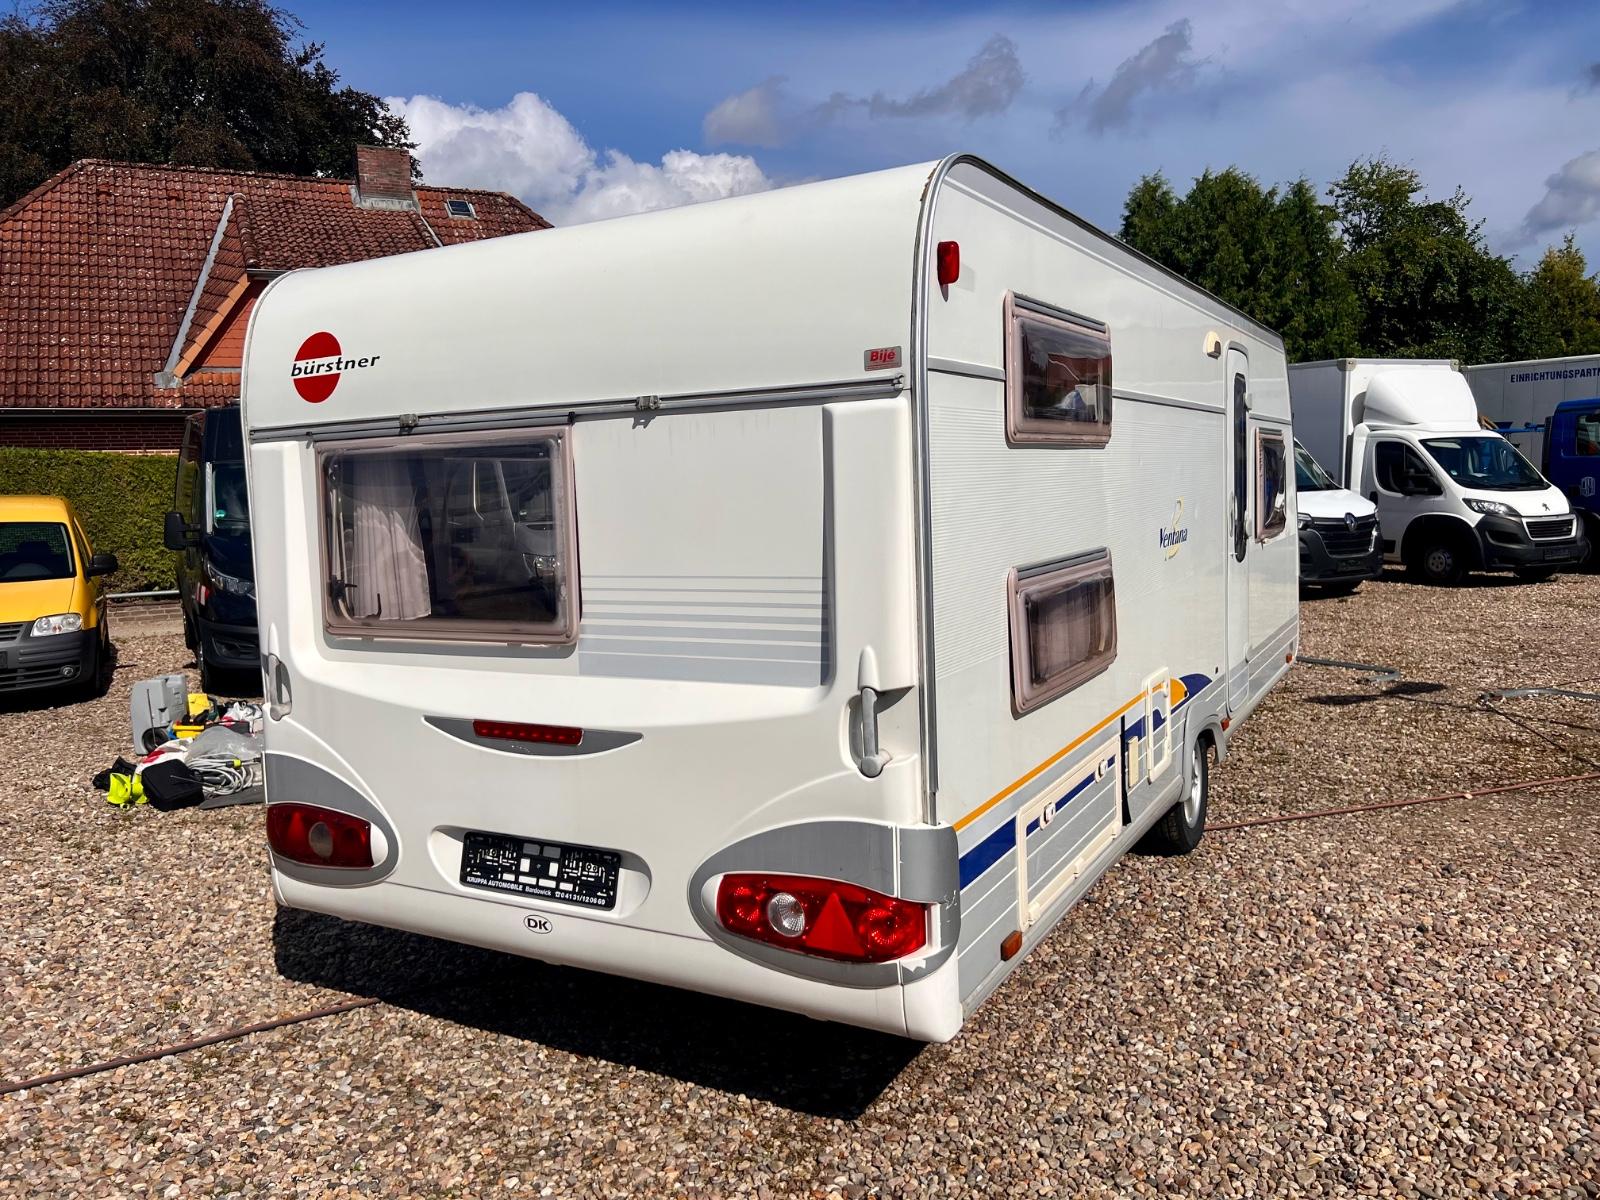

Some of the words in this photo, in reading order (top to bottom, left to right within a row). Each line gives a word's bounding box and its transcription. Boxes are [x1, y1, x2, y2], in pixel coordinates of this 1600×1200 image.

[291, 355, 380, 377] bürstner
[1160, 527, 1188, 548] Ventana
[466, 876, 488, 885] KRUPPA
[488, 879, 523, 891] AUTOMOBILE
[525, 886, 552, 896] Bardowick
[527, 918, 549, 931] DK
